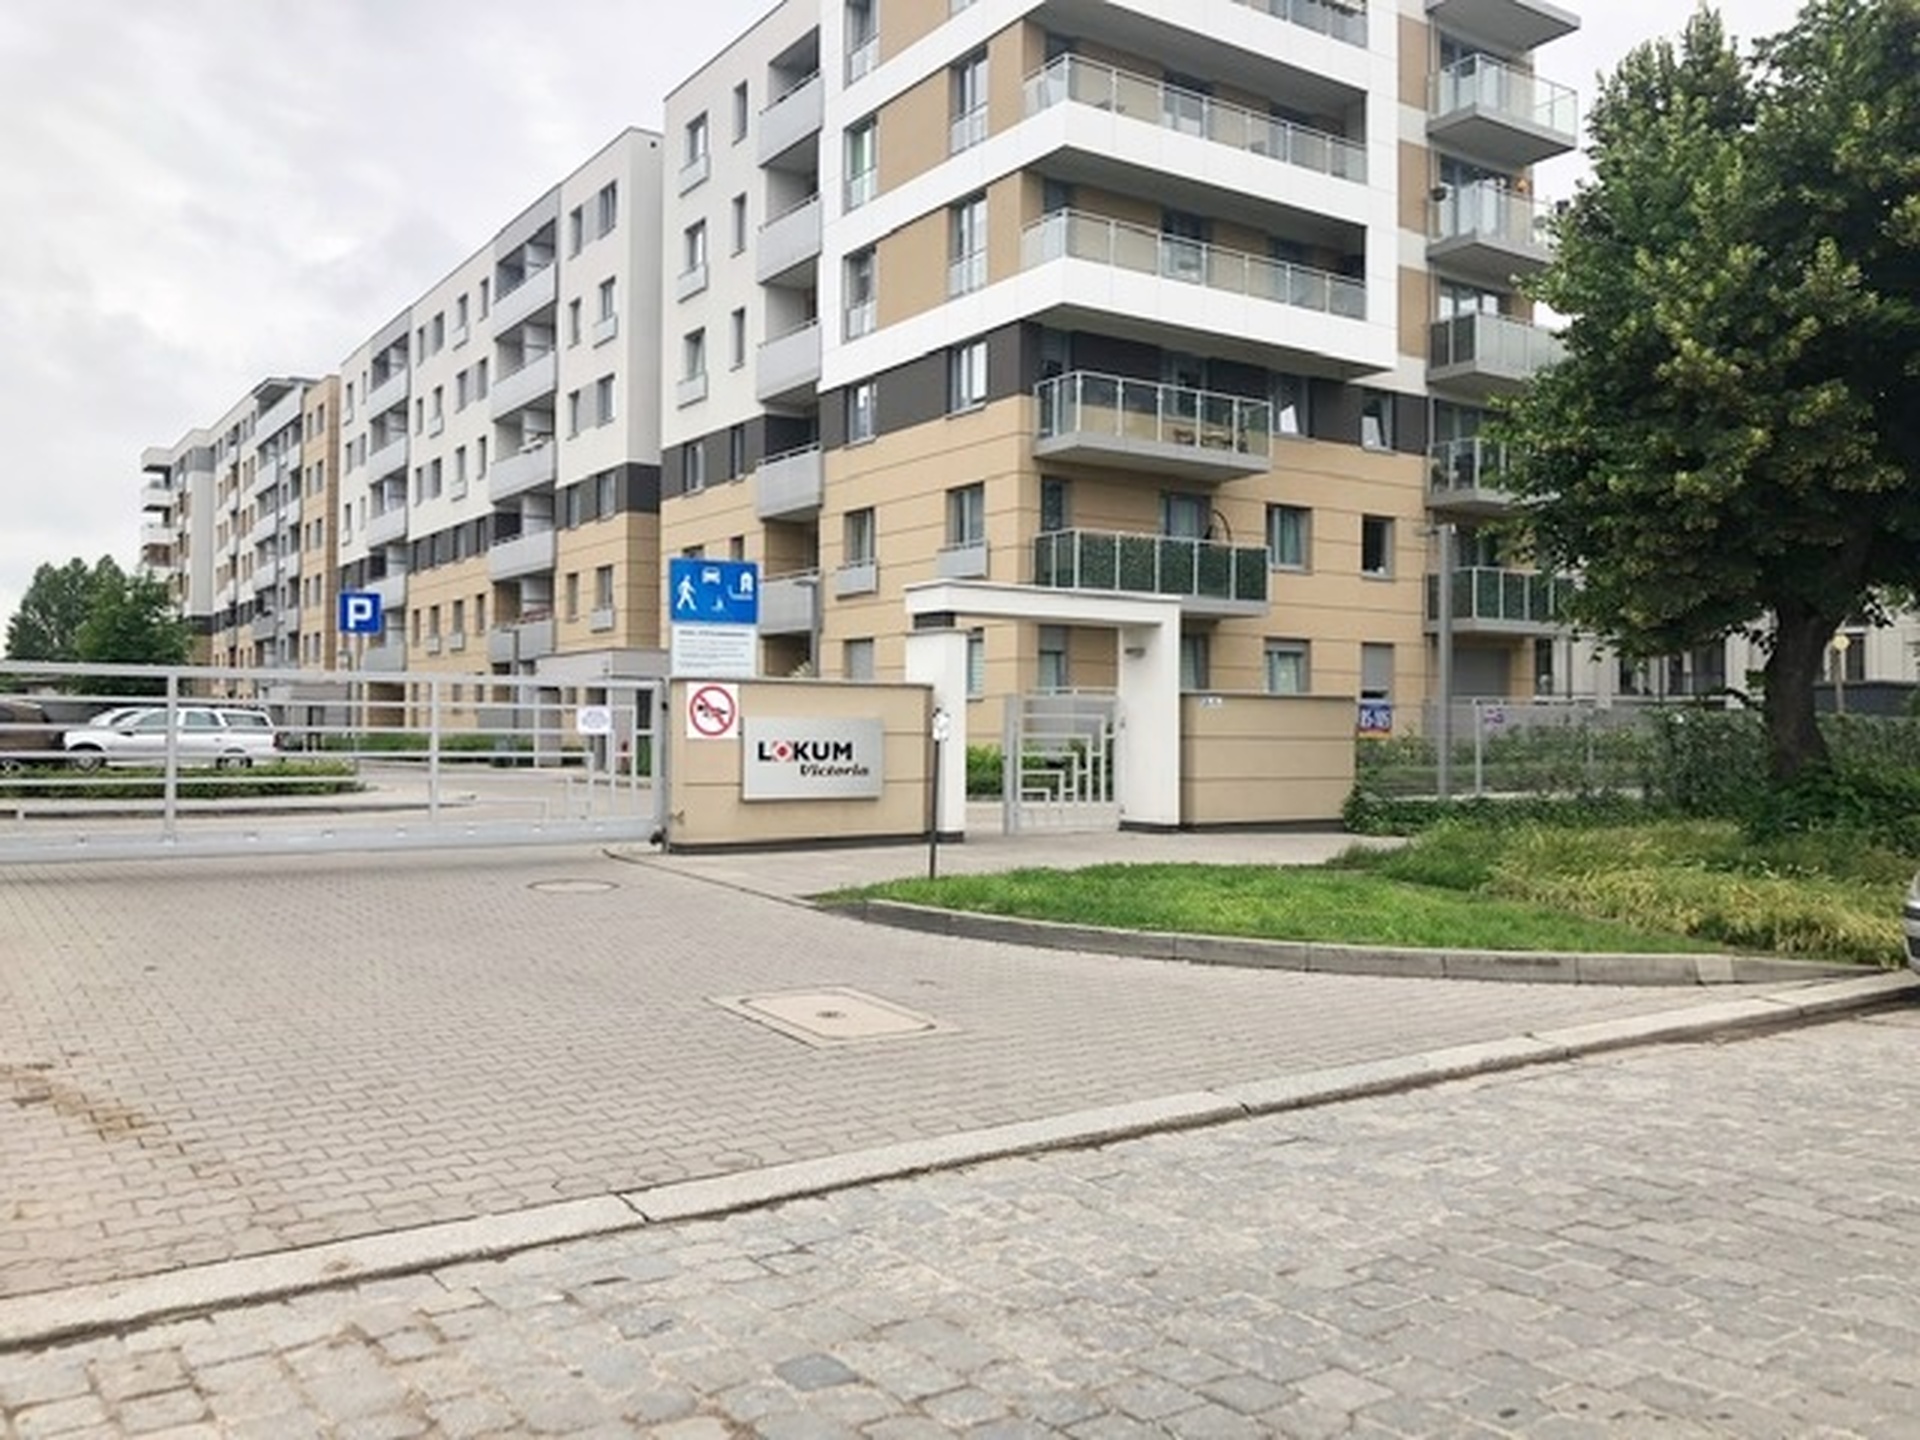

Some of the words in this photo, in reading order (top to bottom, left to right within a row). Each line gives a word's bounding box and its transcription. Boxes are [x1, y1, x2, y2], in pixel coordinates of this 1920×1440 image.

[348, 598, 372, 628] P
[758, 740, 853, 761] LOKUM
[800, 763, 869, 776] Victoria
